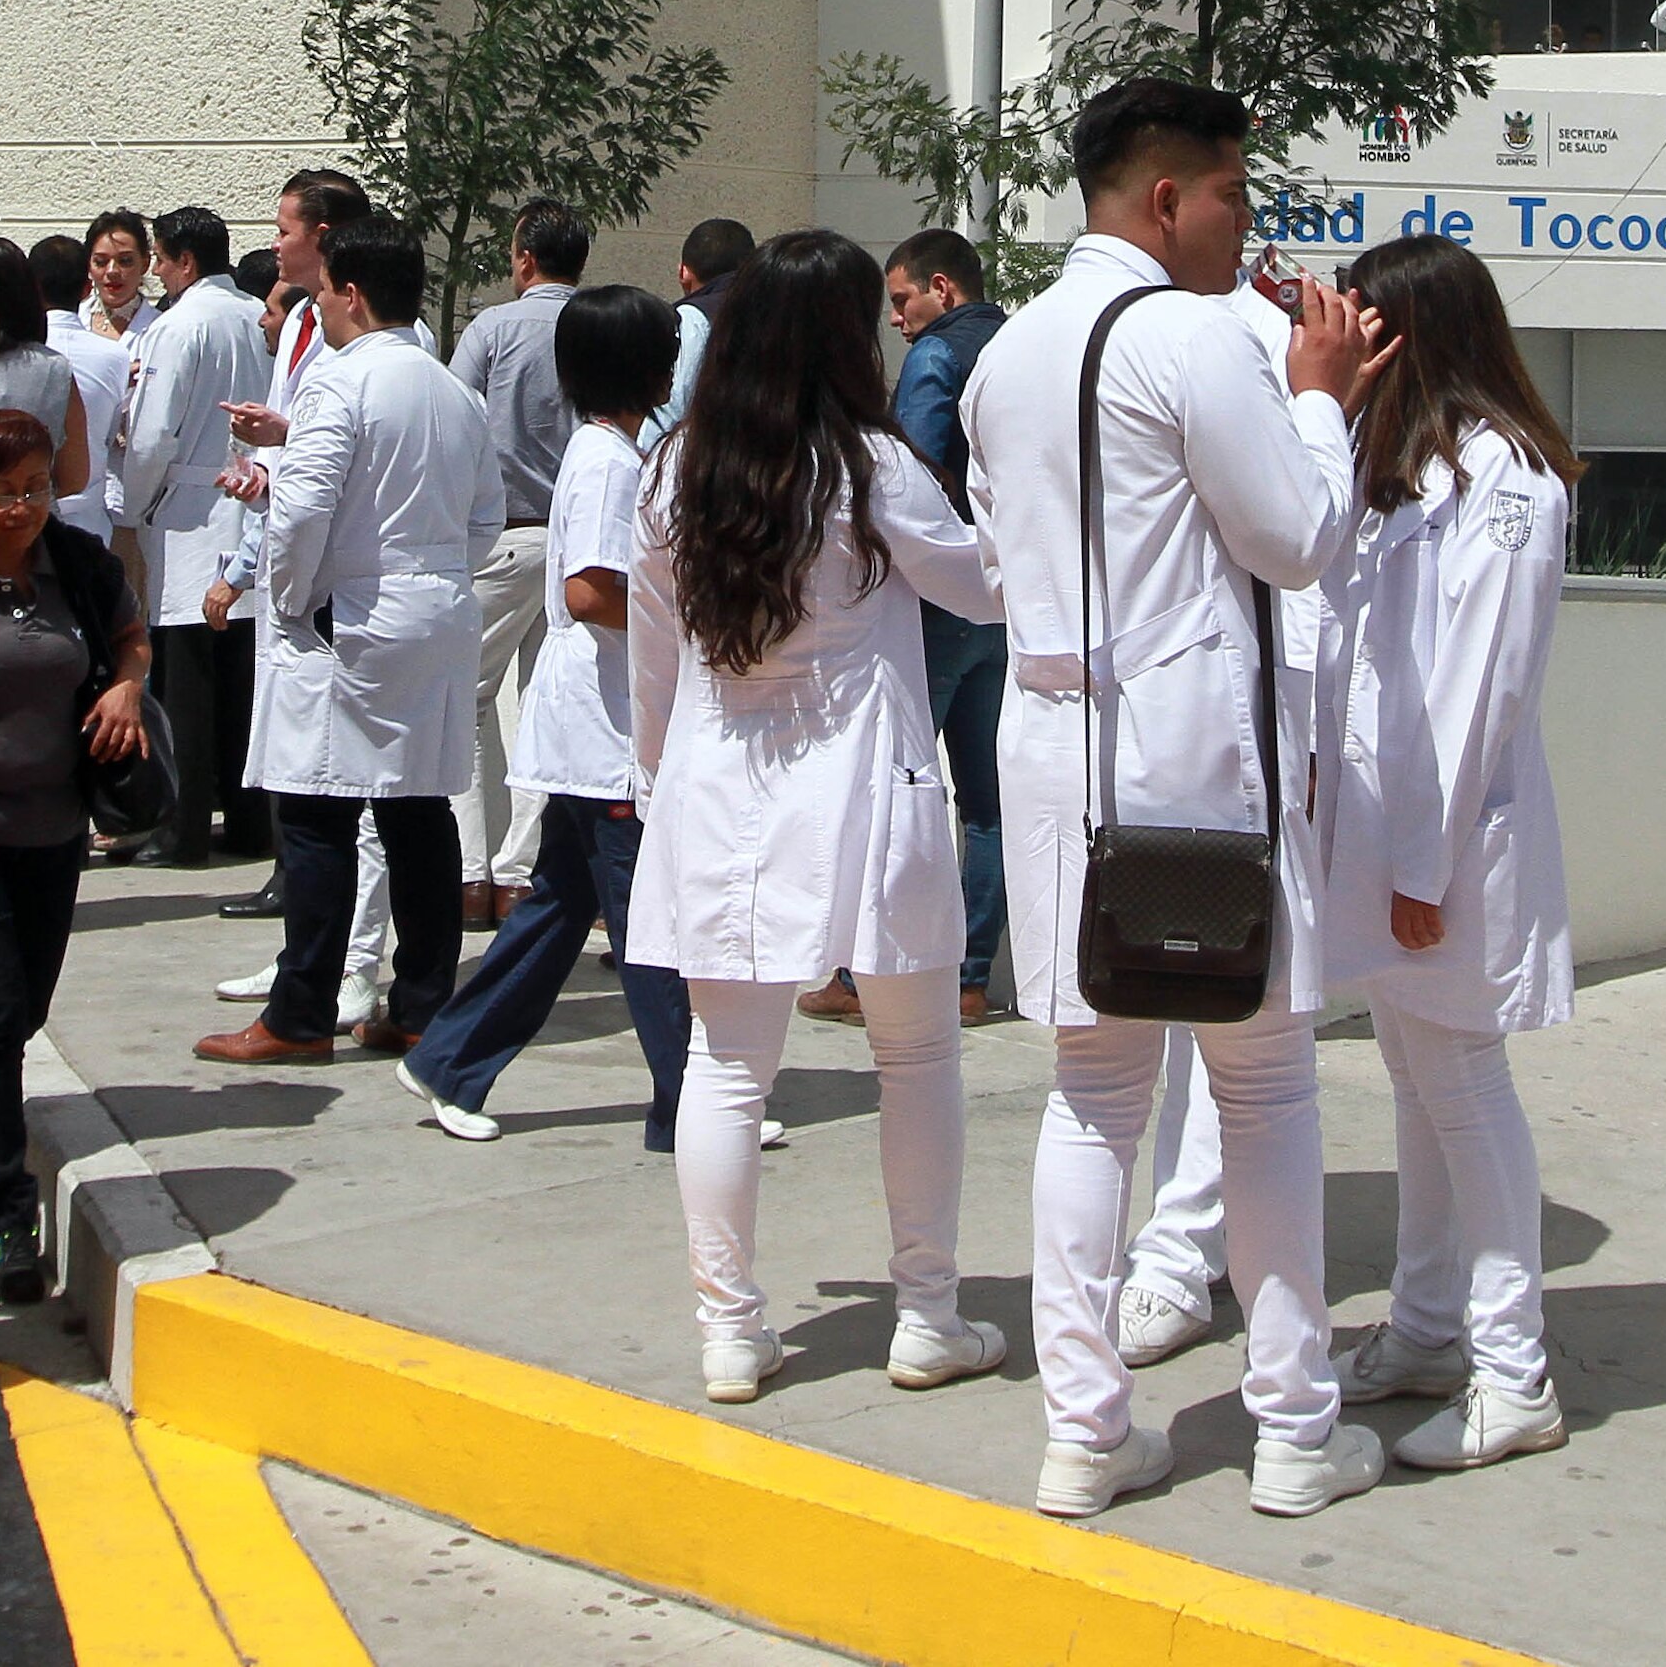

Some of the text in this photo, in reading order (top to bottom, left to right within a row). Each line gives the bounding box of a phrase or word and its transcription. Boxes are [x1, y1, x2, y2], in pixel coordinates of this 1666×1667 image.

[1558, 128, 1619, 141] SECRETARÍA
[1558, 142, 1608, 154] DE SALUD
[1359, 151, 1411, 163] HOMBRO
[1401, 195, 1474, 246] de
